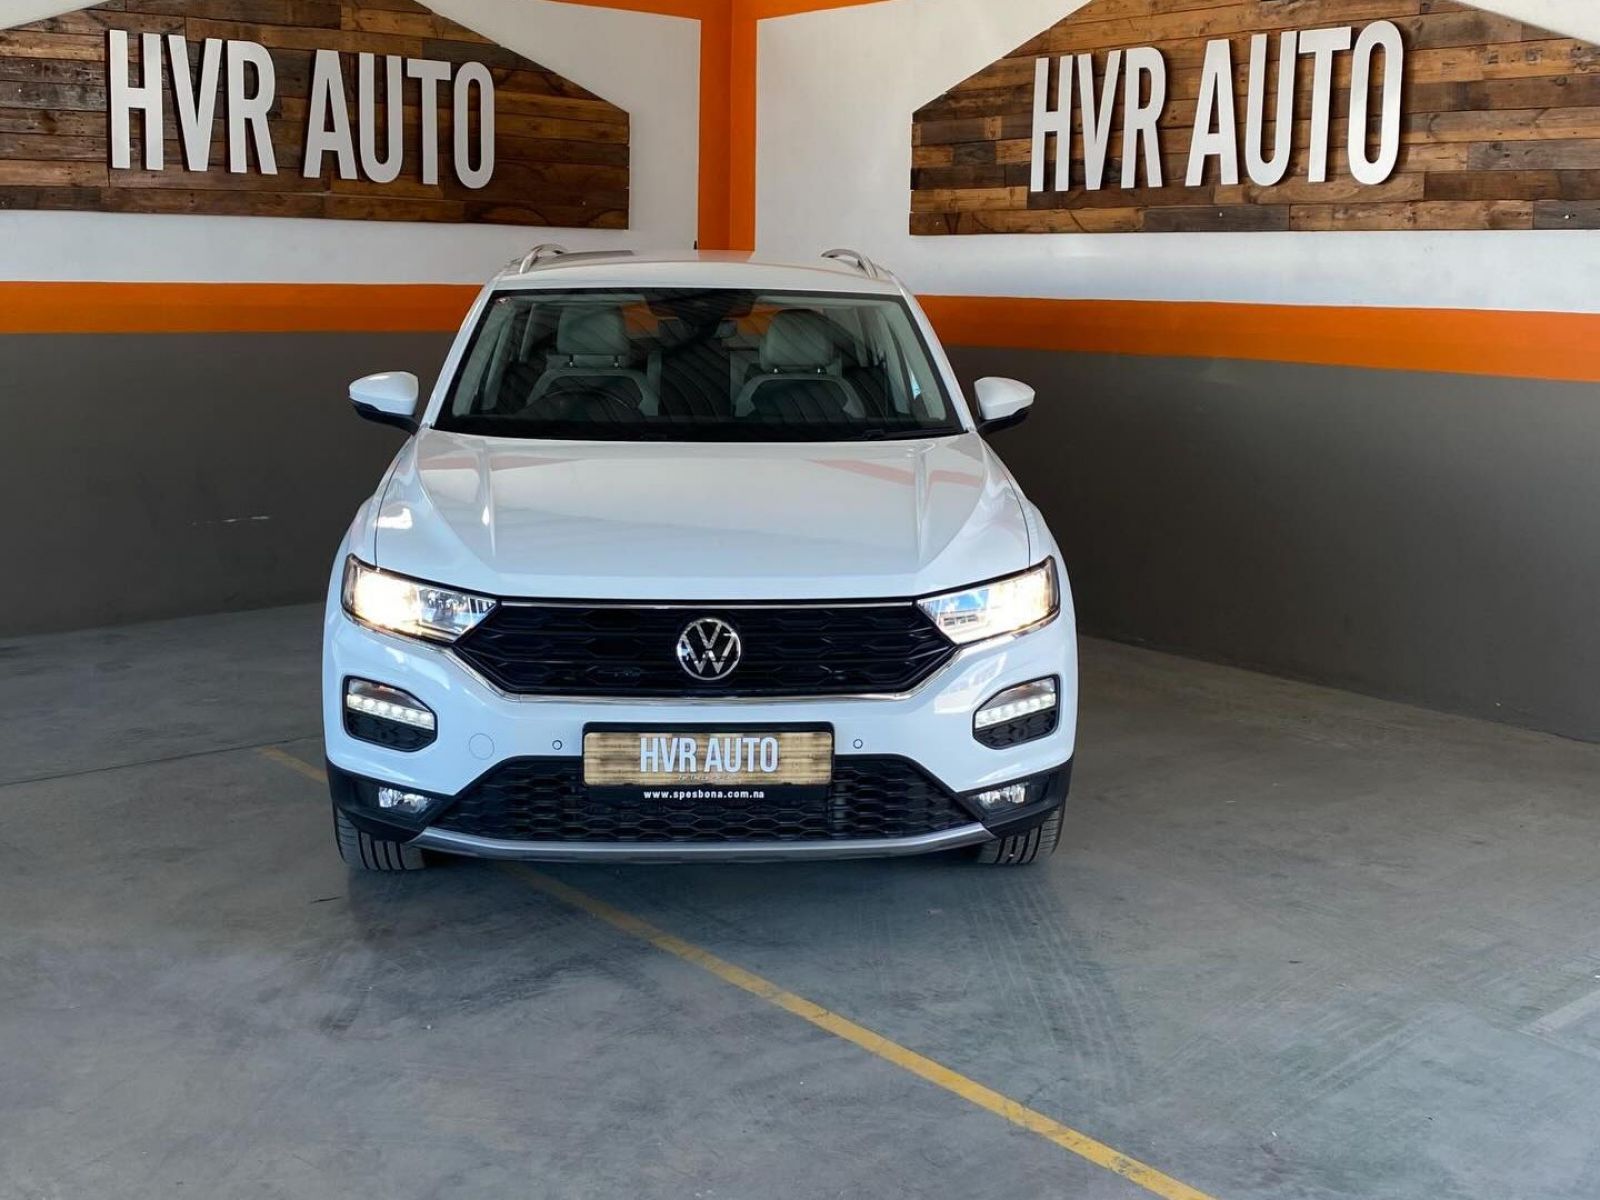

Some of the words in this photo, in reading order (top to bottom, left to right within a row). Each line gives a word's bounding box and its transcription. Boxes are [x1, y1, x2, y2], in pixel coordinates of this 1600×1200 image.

[109, 29, 278, 175] HVR
[303, 49, 495, 190] AUTO
[1030, 46, 1166, 192] HVR
[1185, 20, 1402, 187] AUTO
[640, 737, 697, 772] HVR
[703, 737, 779, 772] AUTO
